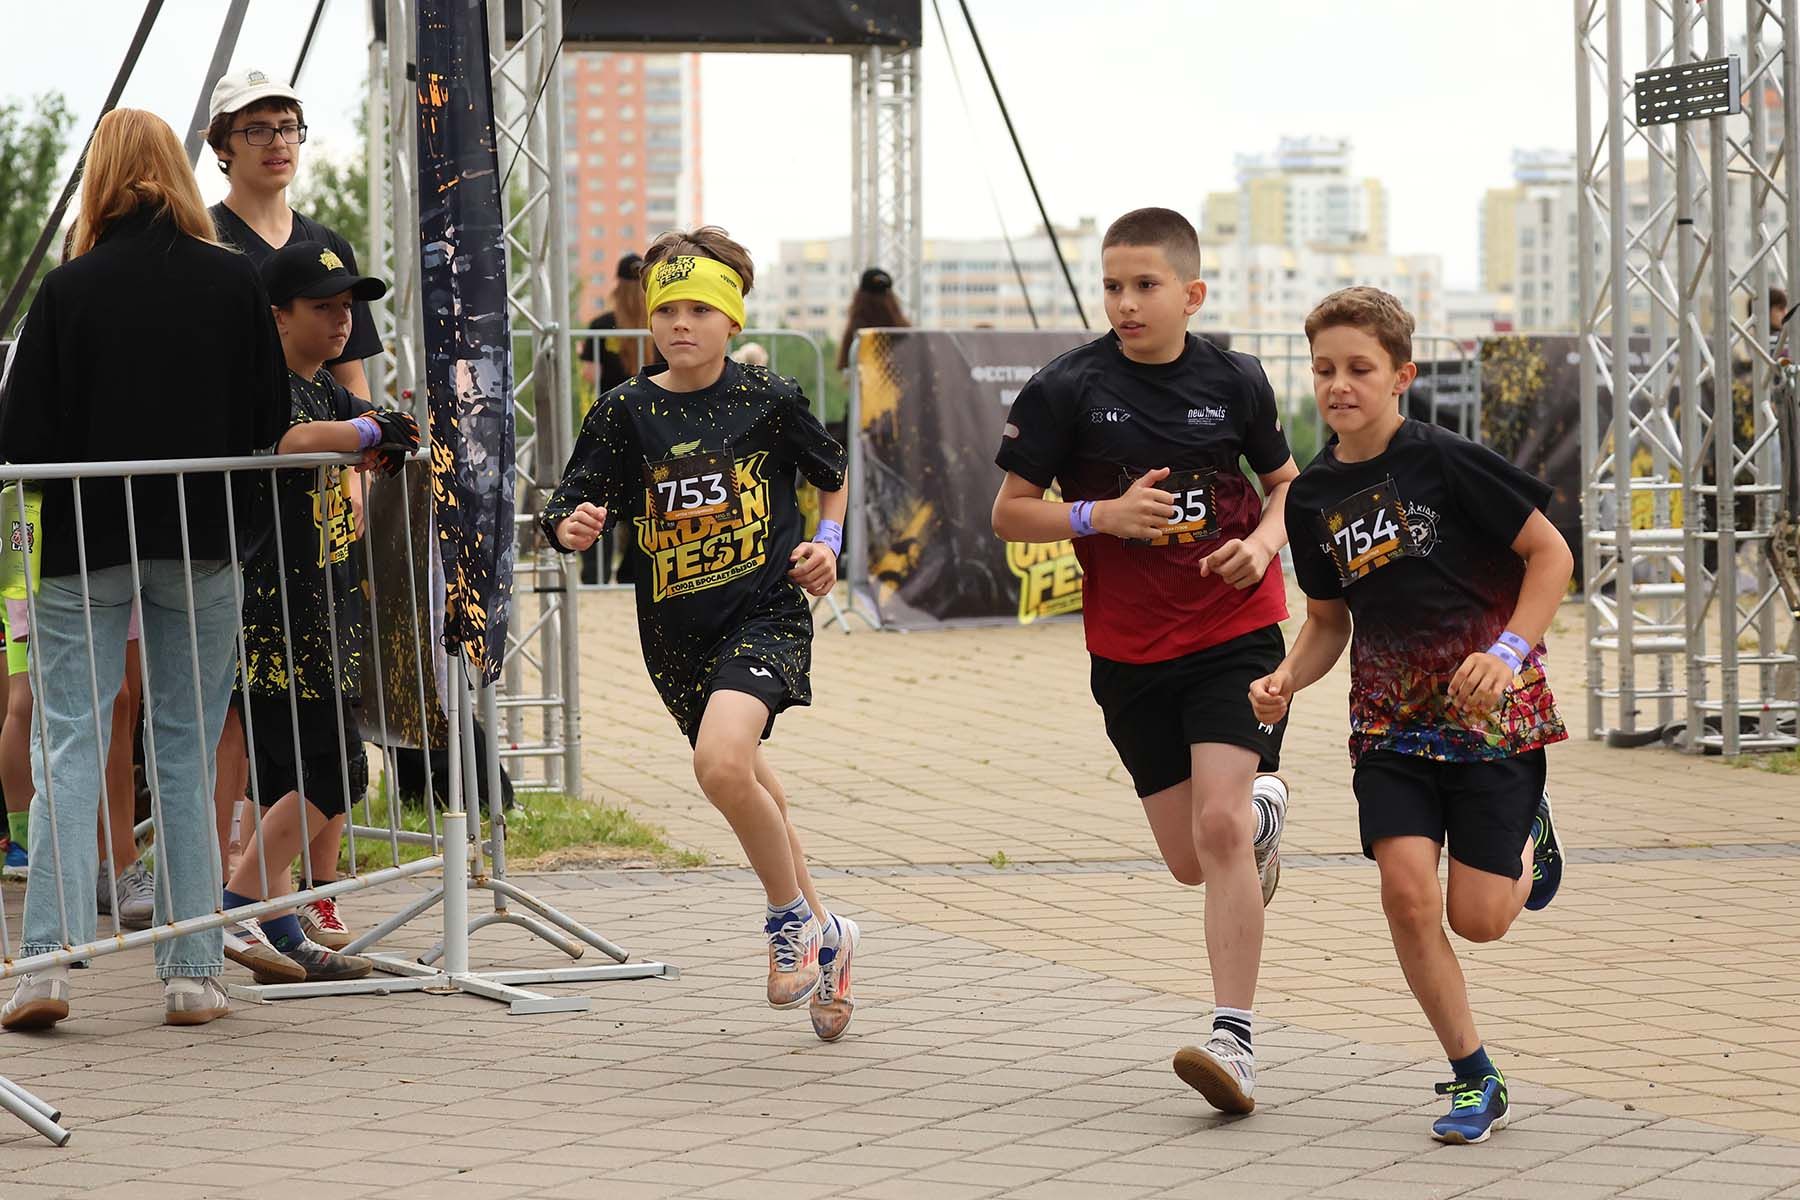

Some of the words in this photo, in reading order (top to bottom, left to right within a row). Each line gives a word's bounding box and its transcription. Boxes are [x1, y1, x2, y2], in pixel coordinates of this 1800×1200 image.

[657, 473, 728, 512] 753
[1167, 489, 1206, 525] 55
[1416, 504, 1437, 518] KIDS
[1333, 508, 1400, 562] 754
[656, 520, 763, 592] FEST
[671, 582, 695, 592] ГОРОД
[695, 571, 730, 586] БРОСАЕТ
[730, 558, 758, 575] ВЫЗОВ
